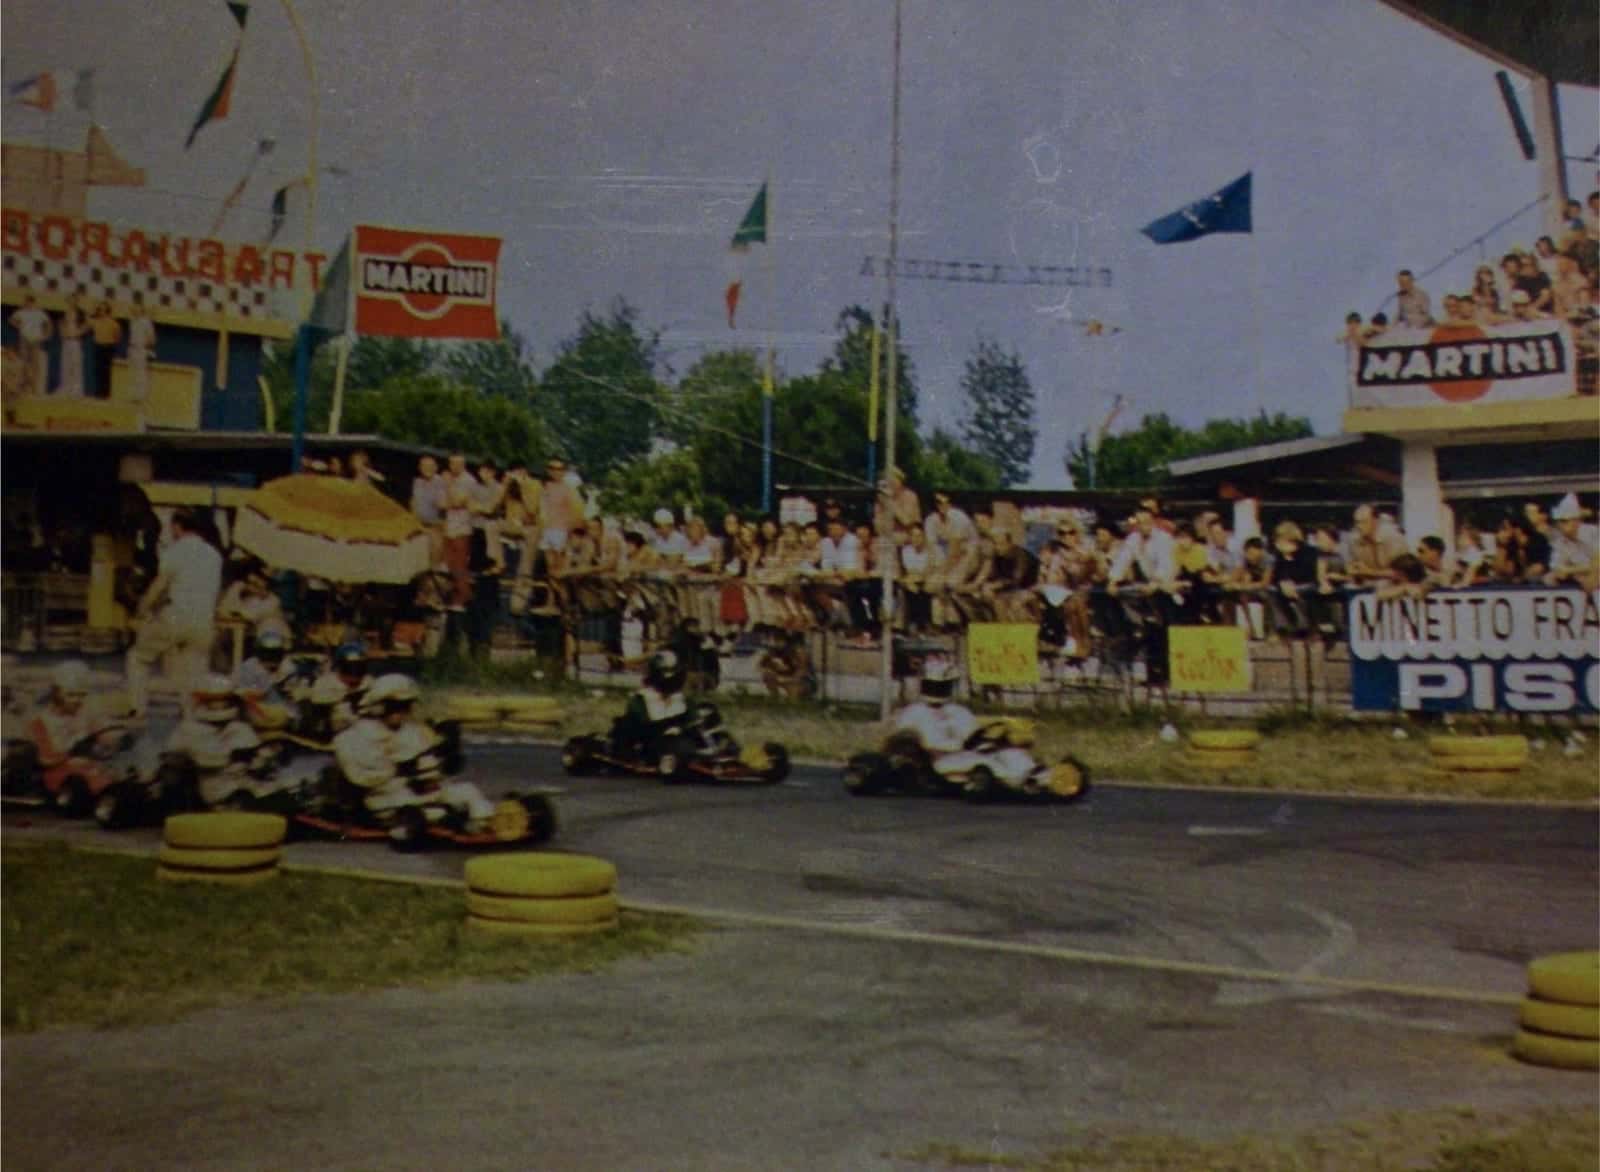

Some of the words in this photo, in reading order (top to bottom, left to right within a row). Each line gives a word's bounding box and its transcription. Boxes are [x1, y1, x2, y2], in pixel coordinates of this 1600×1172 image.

[365, 260, 487, 297] MARTINI
[1361, 336, 1558, 381] MARTINI
[1358, 596, 1514, 642] MINETTO
[1398, 662, 1600, 712] PIS
